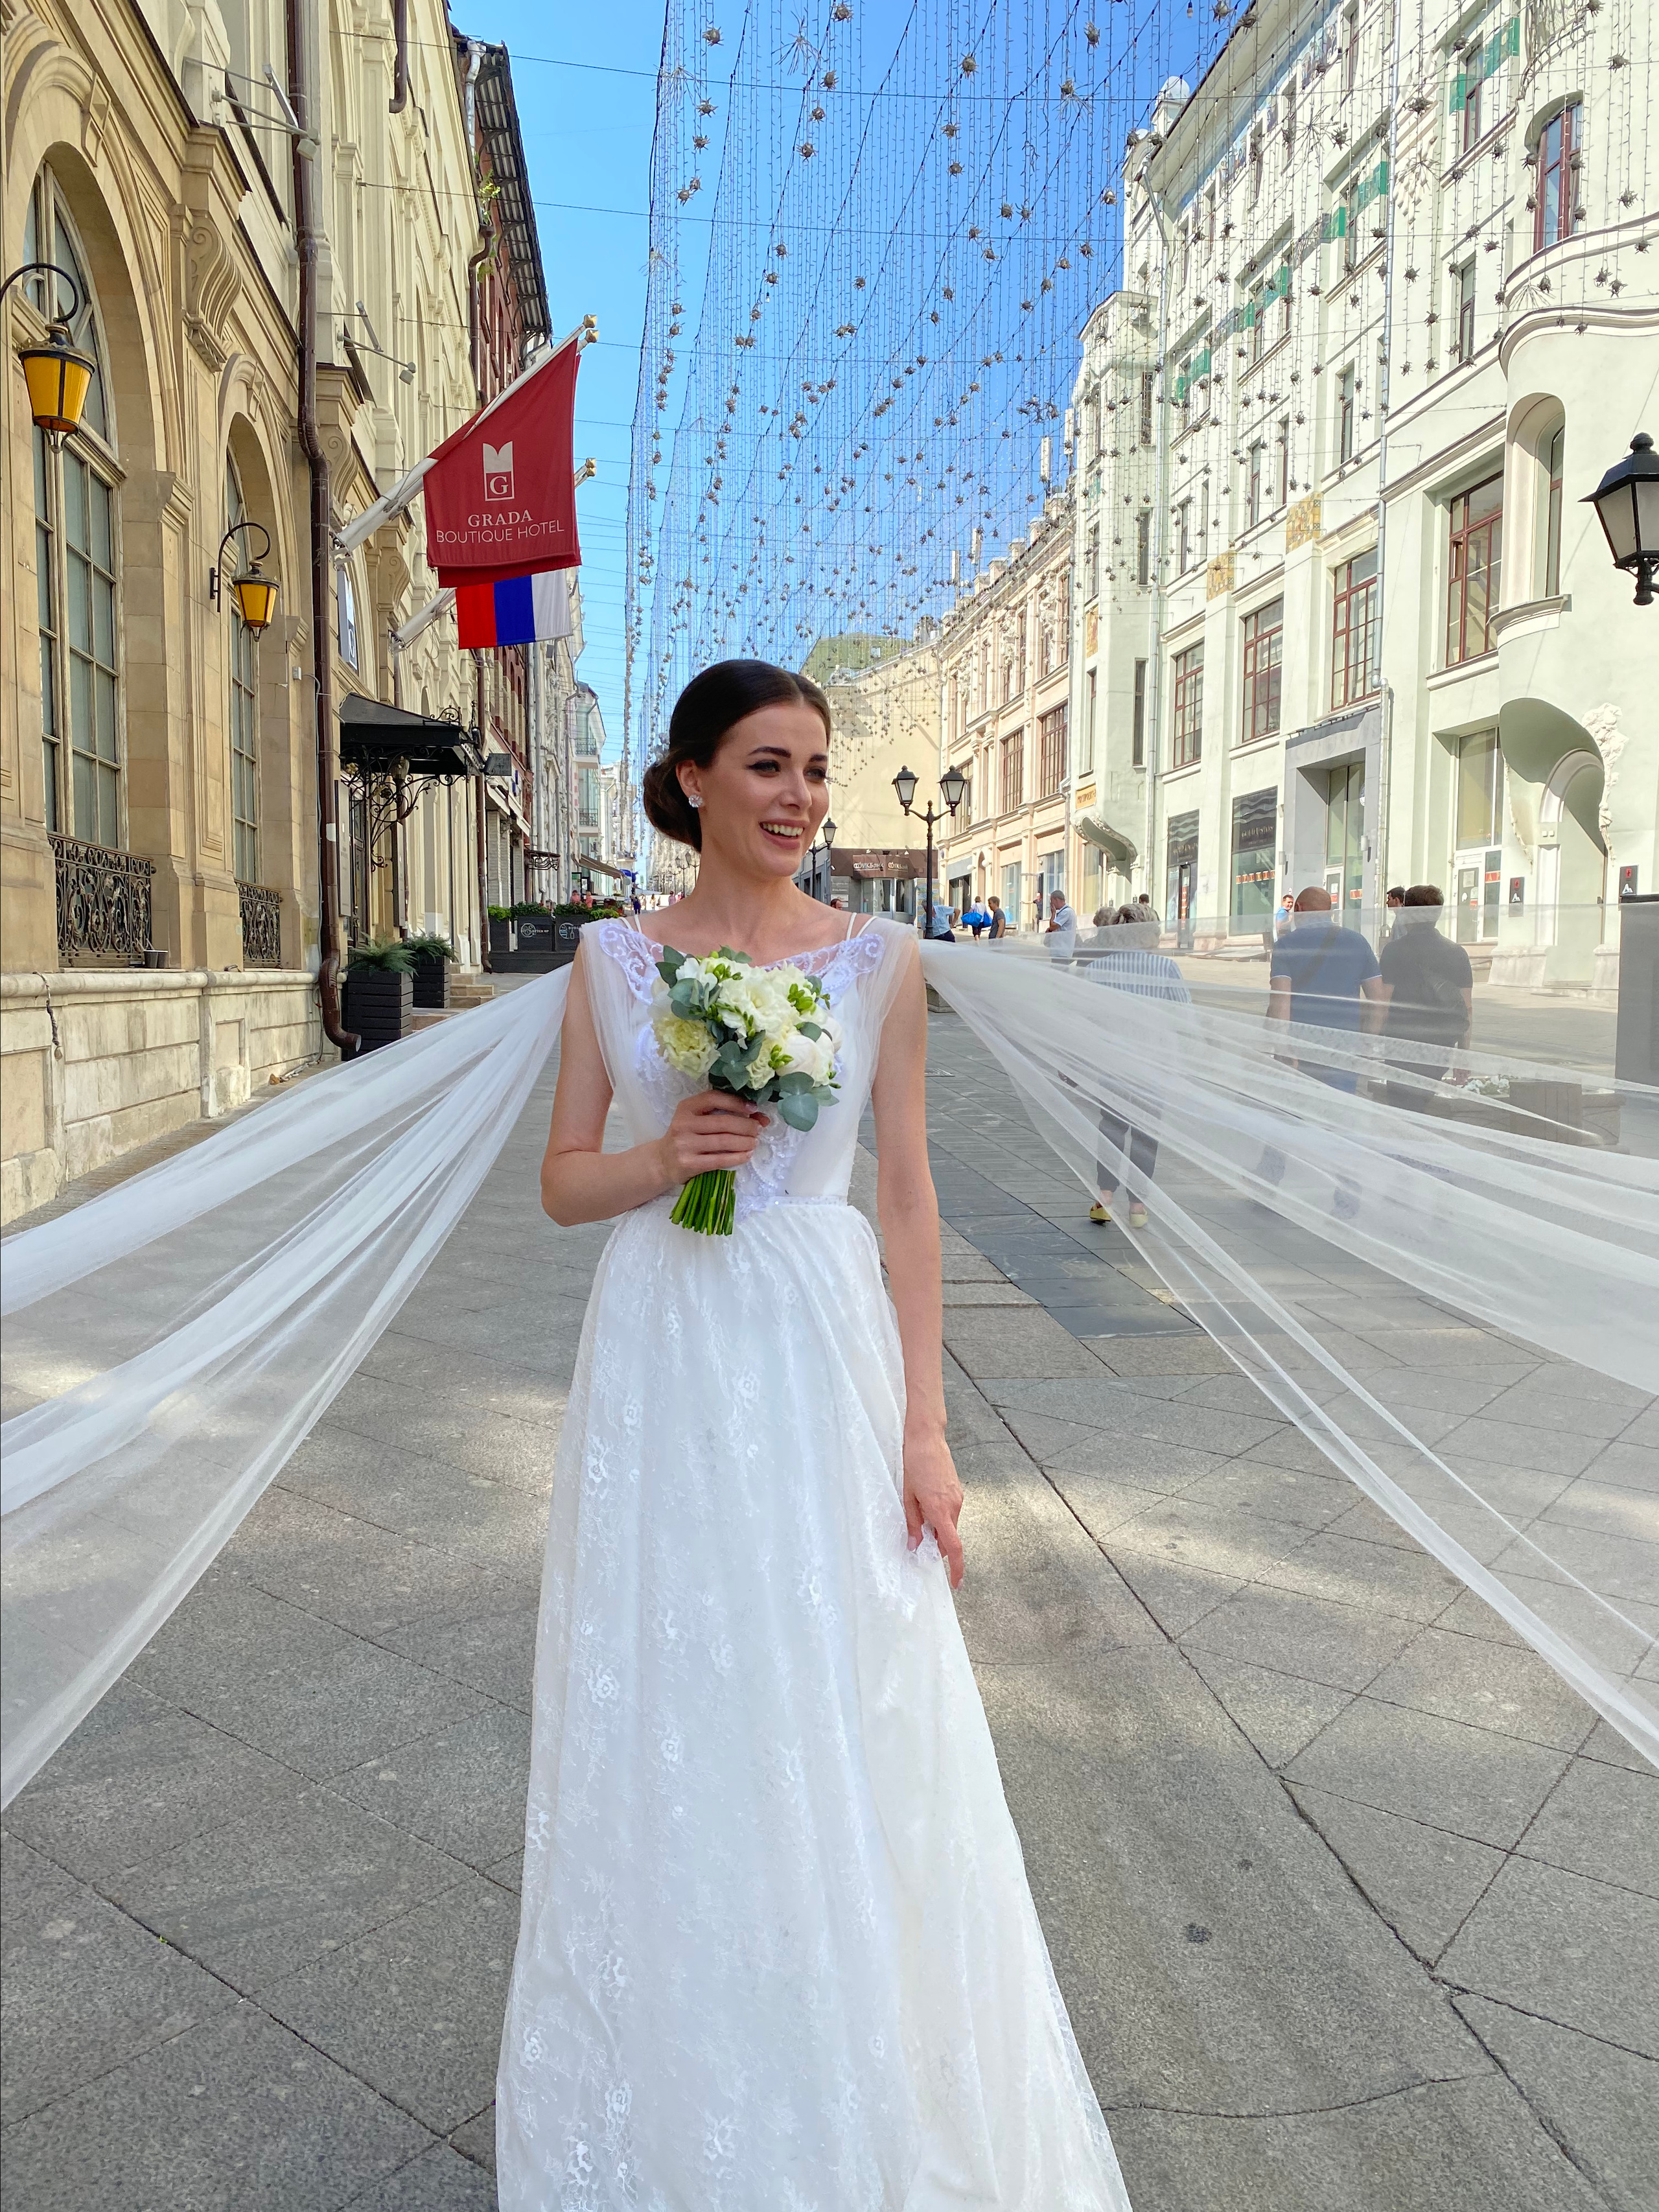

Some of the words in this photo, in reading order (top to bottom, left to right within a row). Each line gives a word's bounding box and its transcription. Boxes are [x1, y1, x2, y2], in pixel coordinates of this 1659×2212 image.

[489, 476, 509, 495] G
[467, 509, 533, 528] GRADA
[436, 528, 513, 544] BOUTIQUE
[518, 519, 565, 539] HOTEL
